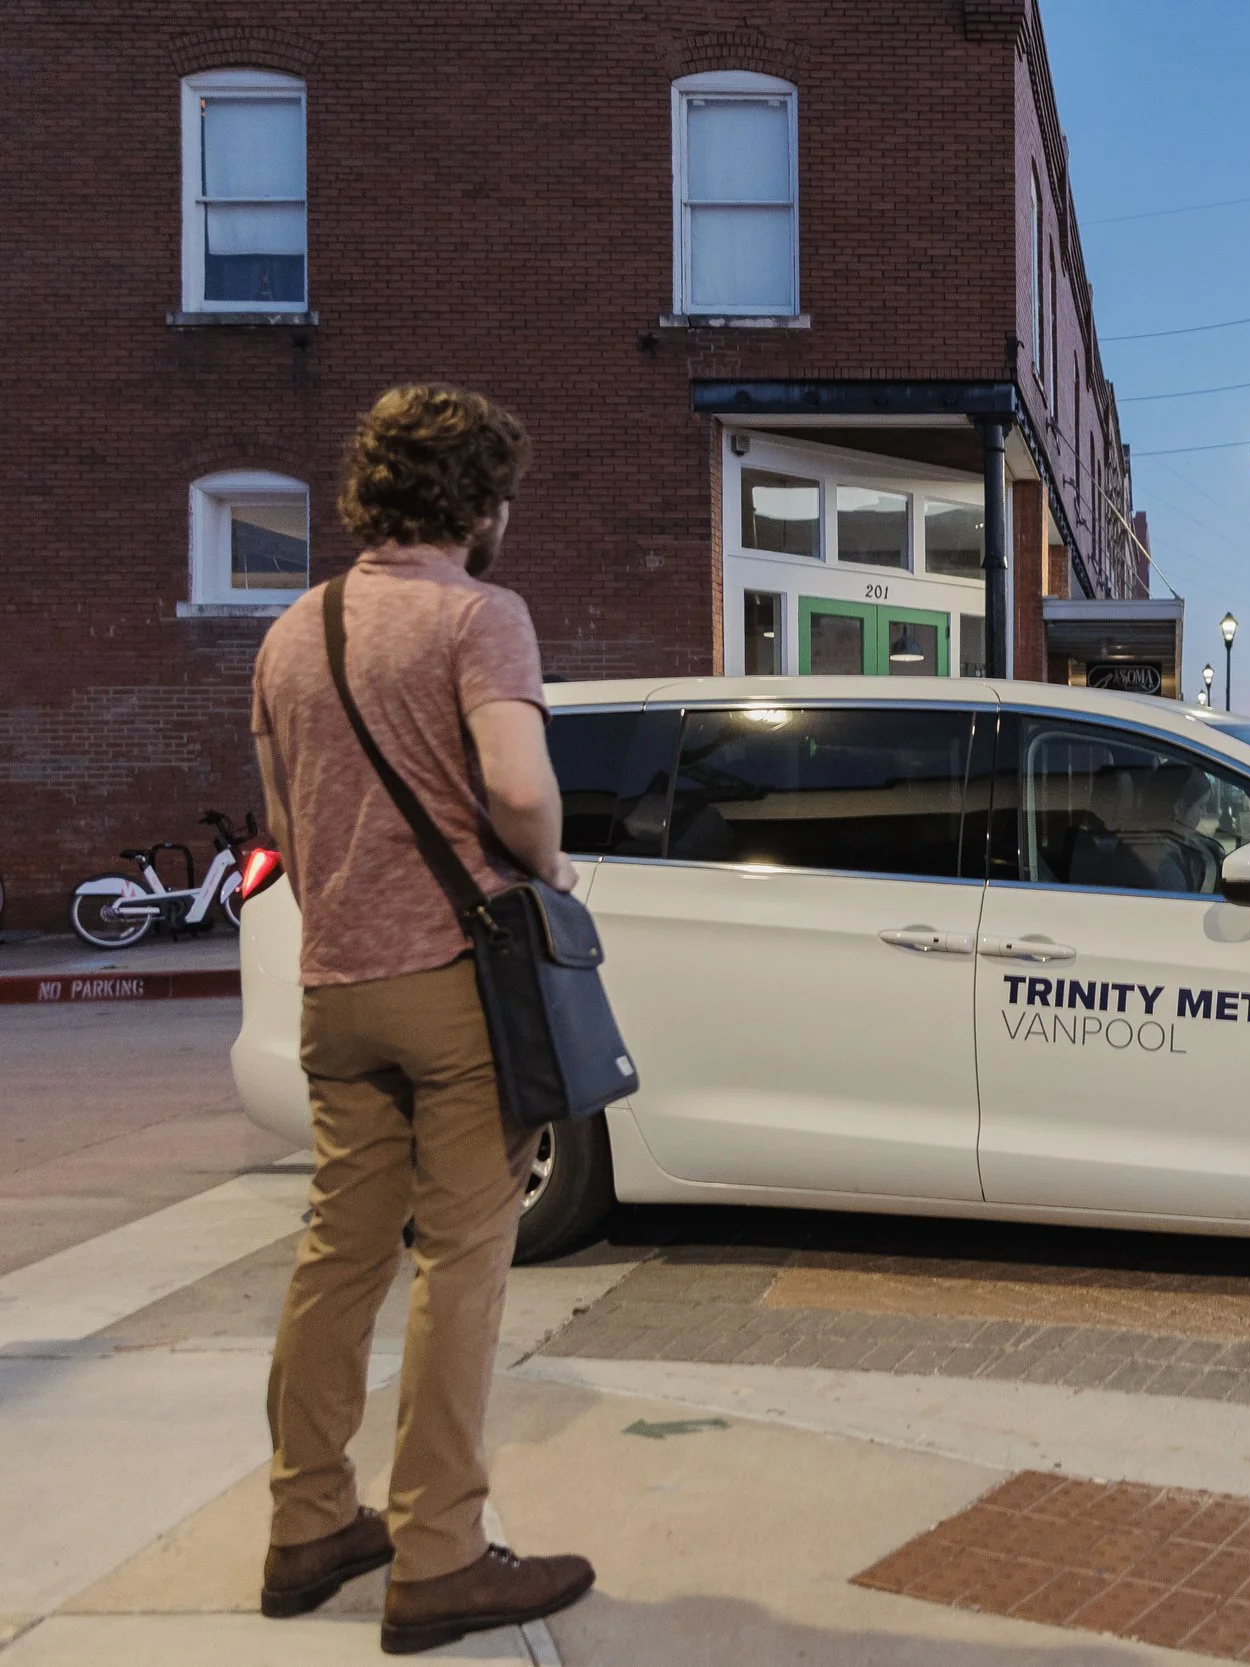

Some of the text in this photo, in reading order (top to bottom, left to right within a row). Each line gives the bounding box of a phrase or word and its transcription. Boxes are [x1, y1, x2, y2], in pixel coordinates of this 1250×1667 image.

[865, 584, 888, 600] 201
[39, 978, 144, 1000] NO PARKING
[1003, 973, 1165, 1016] TRINITY
[1001, 1009, 1187, 1054] VANPOOL
